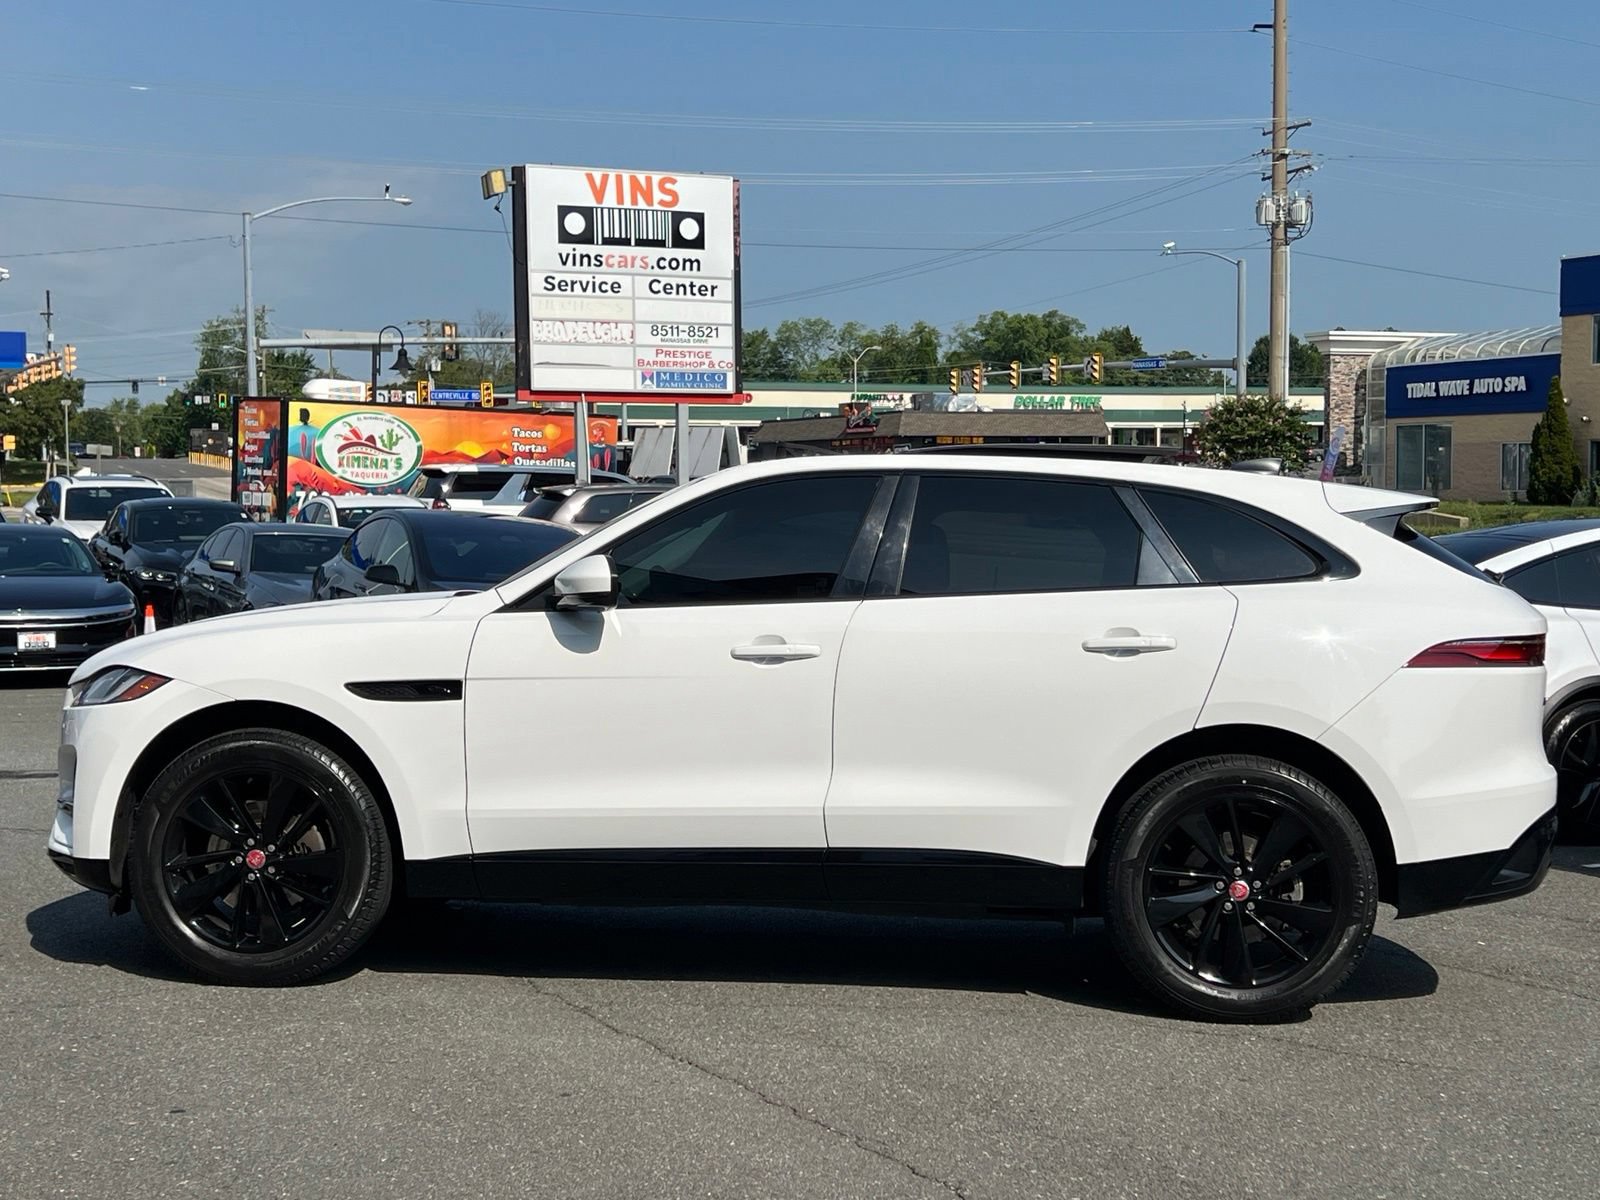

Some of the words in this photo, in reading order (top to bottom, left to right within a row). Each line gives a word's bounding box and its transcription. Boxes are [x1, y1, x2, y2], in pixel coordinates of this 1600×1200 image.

[584, 172, 681, 209] VINS
[558, 248, 702, 273] vinscars.com
[543, 275, 622, 294] Service
[648, 278, 719, 298] Center
[650, 324, 719, 339] 8511-8521
[655, 348, 713, 360] PRESTIGE
[637, 358, 706, 369] BARBERSHOP
[707, 360, 716, 369] &
[660, 372, 724, 382] MEDICO
[1406, 382, 1437, 399] TIDAL
[1438, 379, 1470, 397] WAVE
[1472, 377, 1503, 394] AUTO
[1504, 375, 1527, 392] SPA
[430, 391, 470, 400] CENTREVILLE
[1013, 395, 1065, 409] DOLLAR
[512, 427, 543, 439] Tacos
[511, 442, 548, 453] Tortas
[337, 455, 403, 471] XIMENA'S
[513, 456, 576, 468] Quesadillas
[350, 471, 389, 480] TAQUERIA
